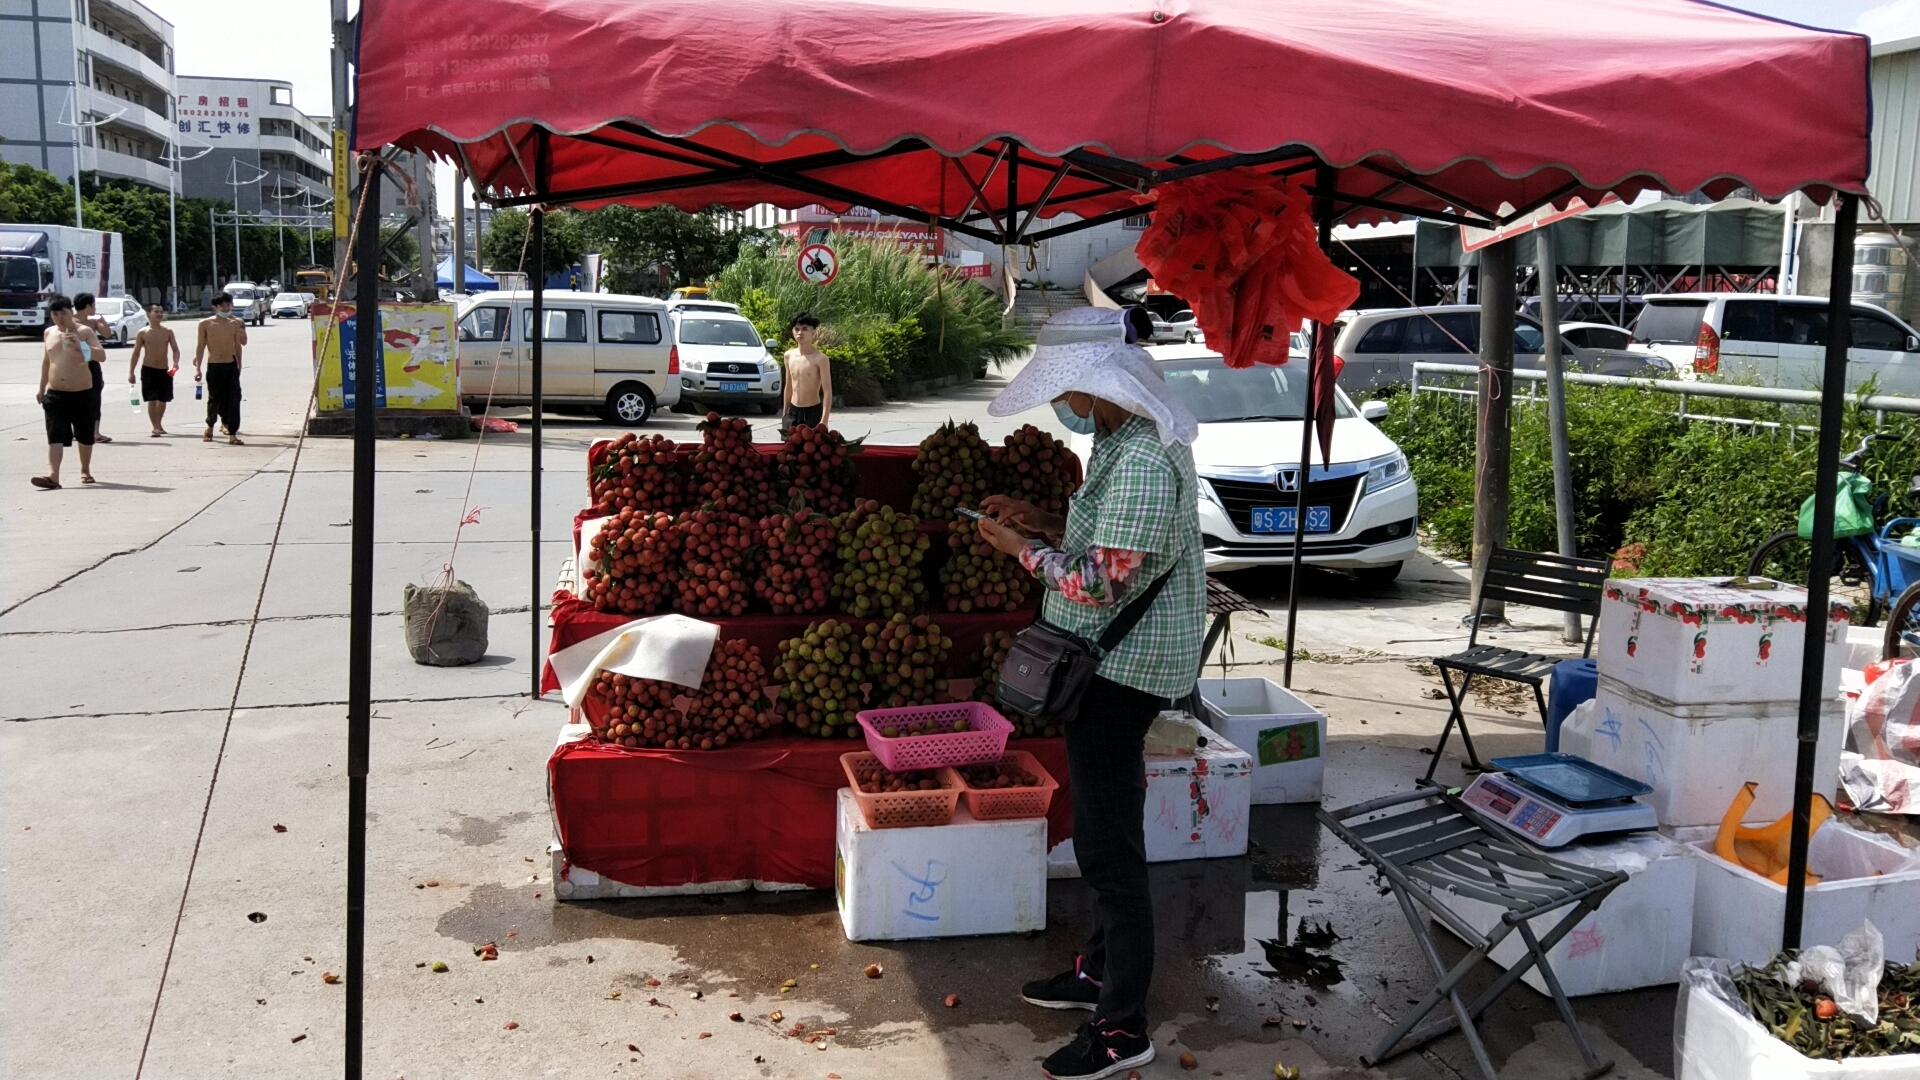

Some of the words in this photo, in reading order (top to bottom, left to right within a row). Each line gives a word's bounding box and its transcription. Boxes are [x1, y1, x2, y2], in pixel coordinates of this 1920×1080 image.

[178, 95, 248, 108] 厂房招租
[178, 119, 250, 135] 创汇快修
